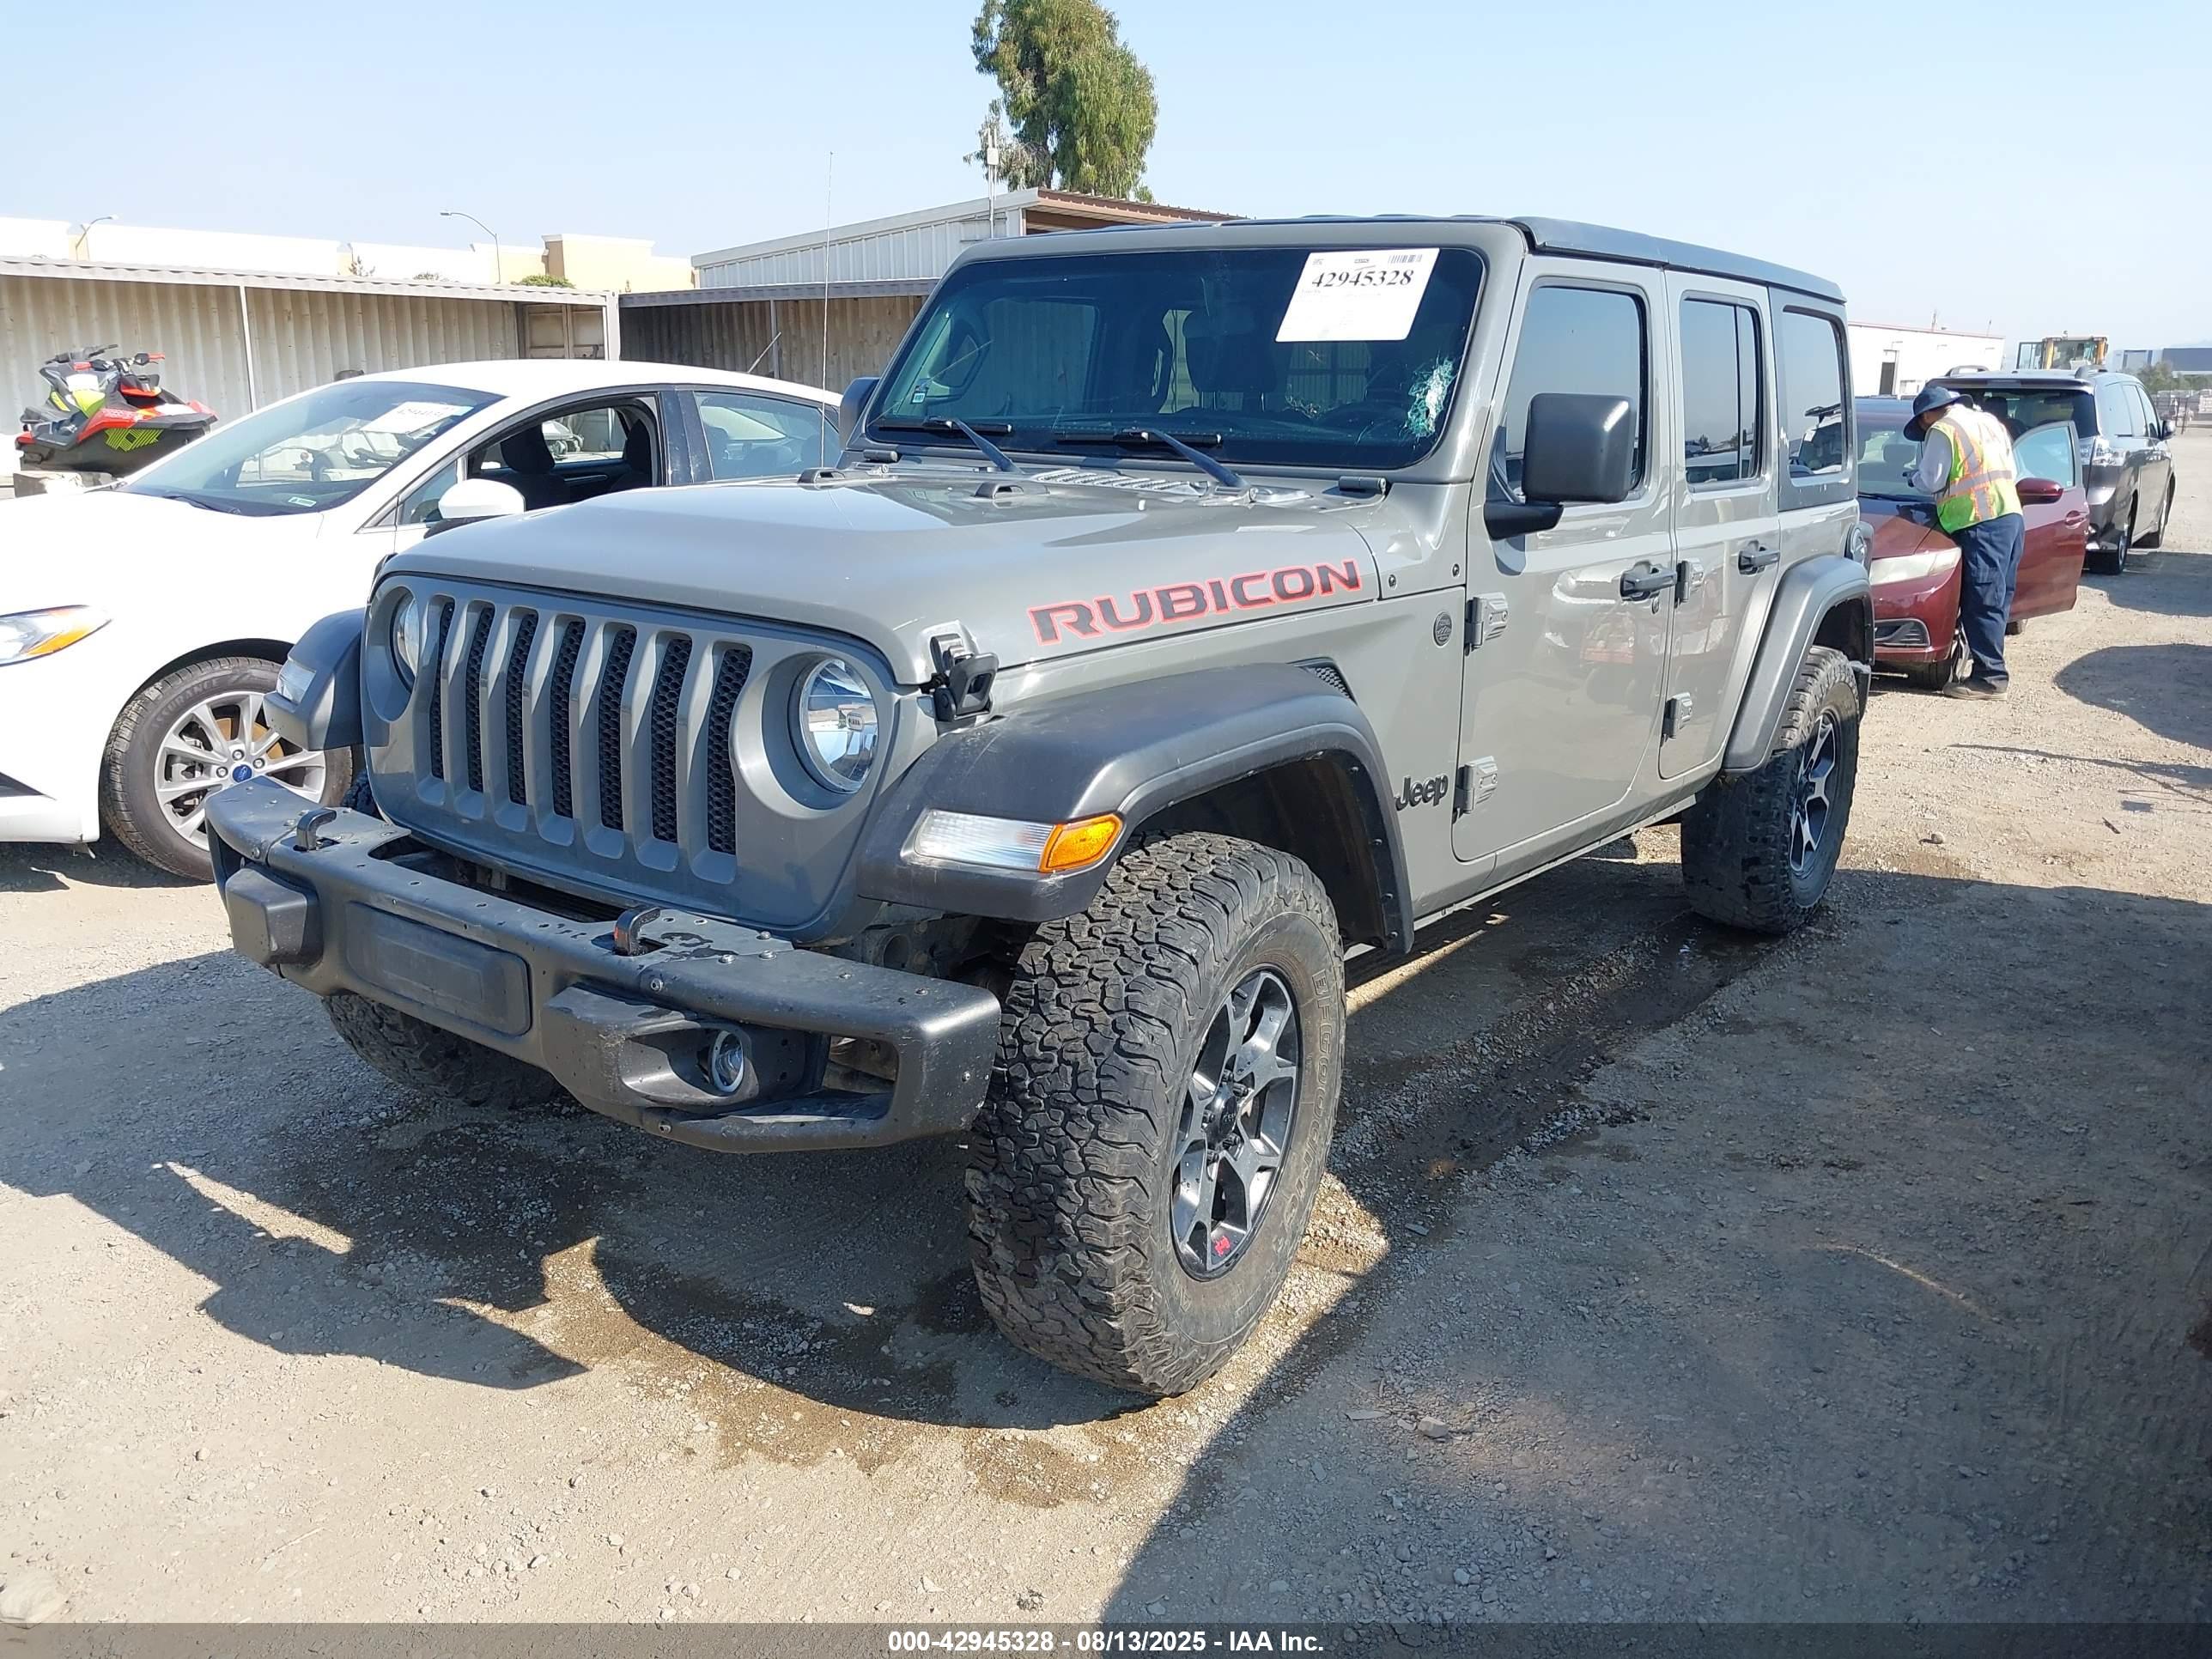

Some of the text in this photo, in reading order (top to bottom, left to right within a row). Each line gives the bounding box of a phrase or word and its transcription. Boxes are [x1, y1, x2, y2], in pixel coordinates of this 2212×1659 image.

[1311, 268, 1415, 288] 42945328
[1027, 557, 1362, 646] RUBICON
[1395, 773, 1449, 811] Jeep
